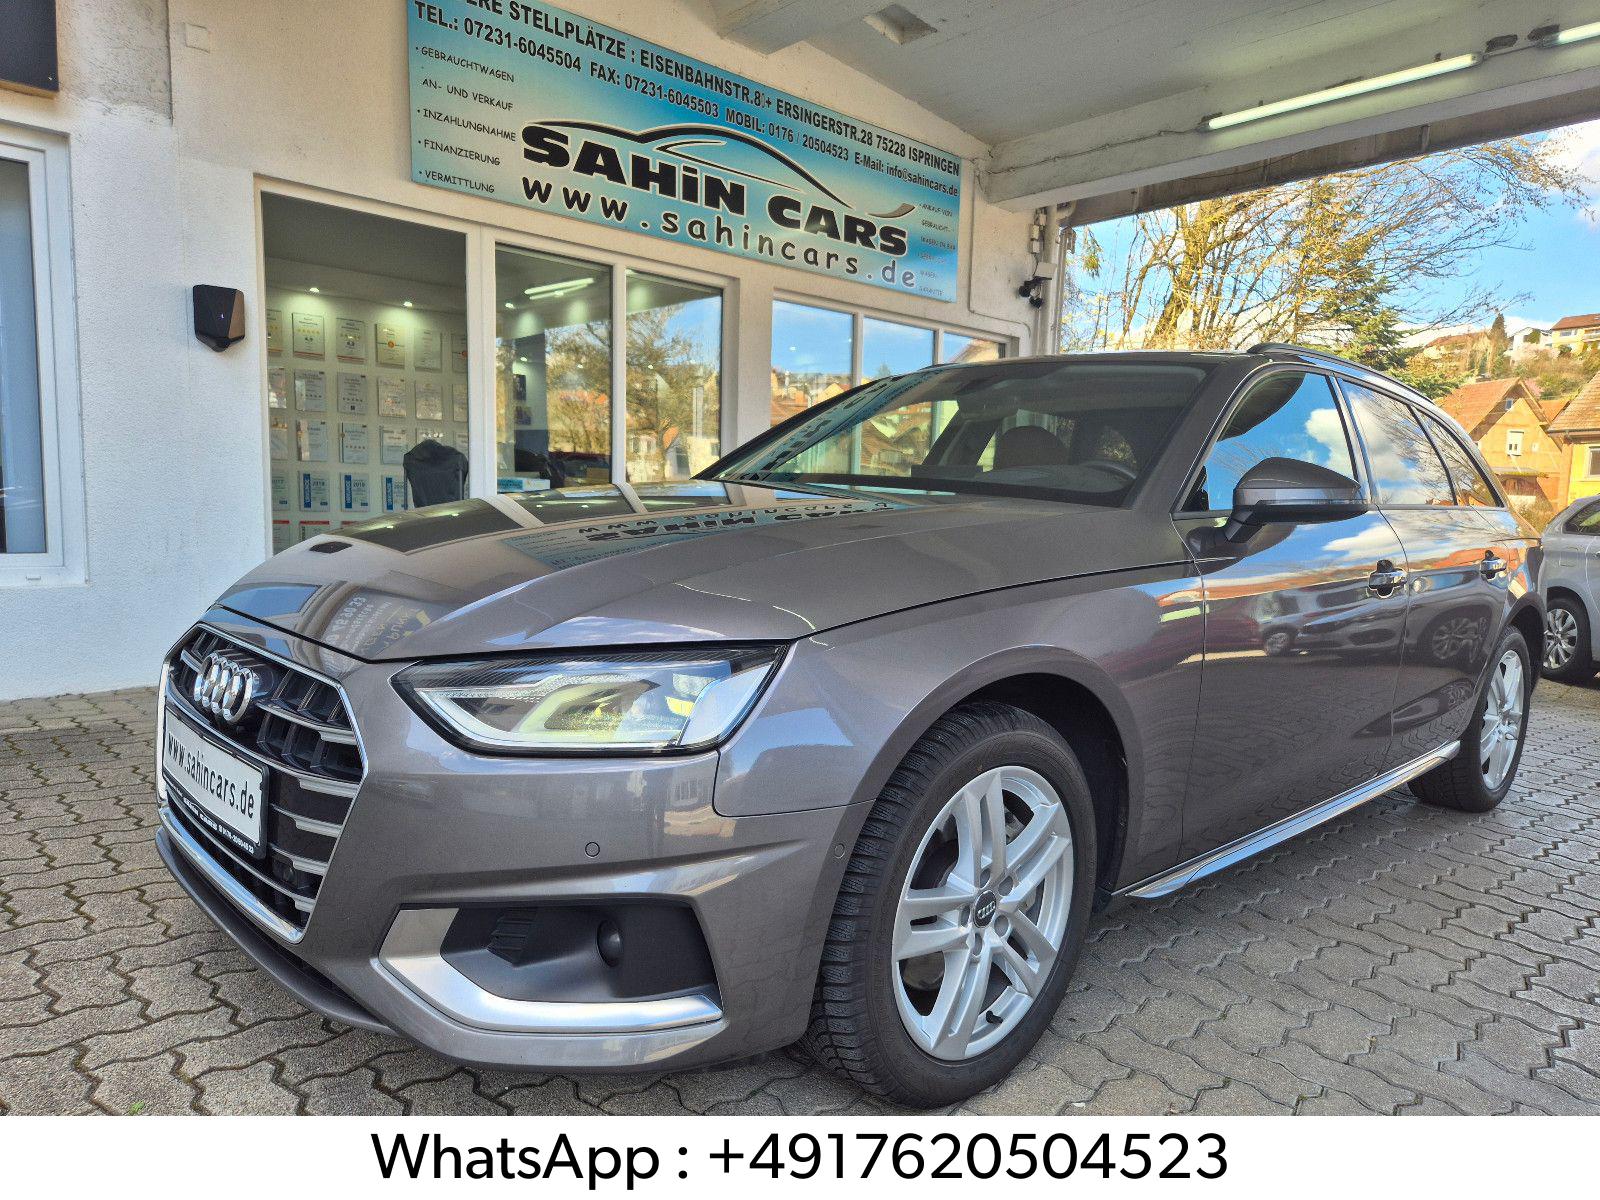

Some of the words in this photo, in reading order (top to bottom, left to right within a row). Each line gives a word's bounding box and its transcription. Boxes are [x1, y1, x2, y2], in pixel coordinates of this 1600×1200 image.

[421, 46, 515, 83] GEBRAUCHTWAGEN
[509, 1, 626, 60] STELLPLÄTZE
[776, 98, 873, 147] ERSINGERSTR.28
[876, 134, 906, 158] 75228
[908, 146, 960, 177] ISPRINGEN
[415, 1, 458, 31] TEL.:
[464, 17, 582, 73] 07231-6045504
[590, 61, 620, 86] FAX:
[624, 73, 719, 118] 07231-6045503
[725, 108, 765, 133] MOBIL:
[768, 122, 794, 143] 0176
[802, 133, 849, 161] 20504523
[854, 151, 884, 173] E-Mail:
[886, 165, 958, 197] info@sahincars.de
[422, 78, 442, 90] AN-
[446, 84, 468, 99] UND
[472, 91, 514, 111] VERKAUF
[423, 108, 516, 141] INZAHLUNGNAHME
[424, 139, 501, 166] FINANZIERUNG
[424, 169, 495, 193] VERMITTLUNG
[522, 176, 915, 288] www.sahincars.de
[767, 195, 907, 257] CARS
[168, 733, 255, 819] www.sahincars.de
